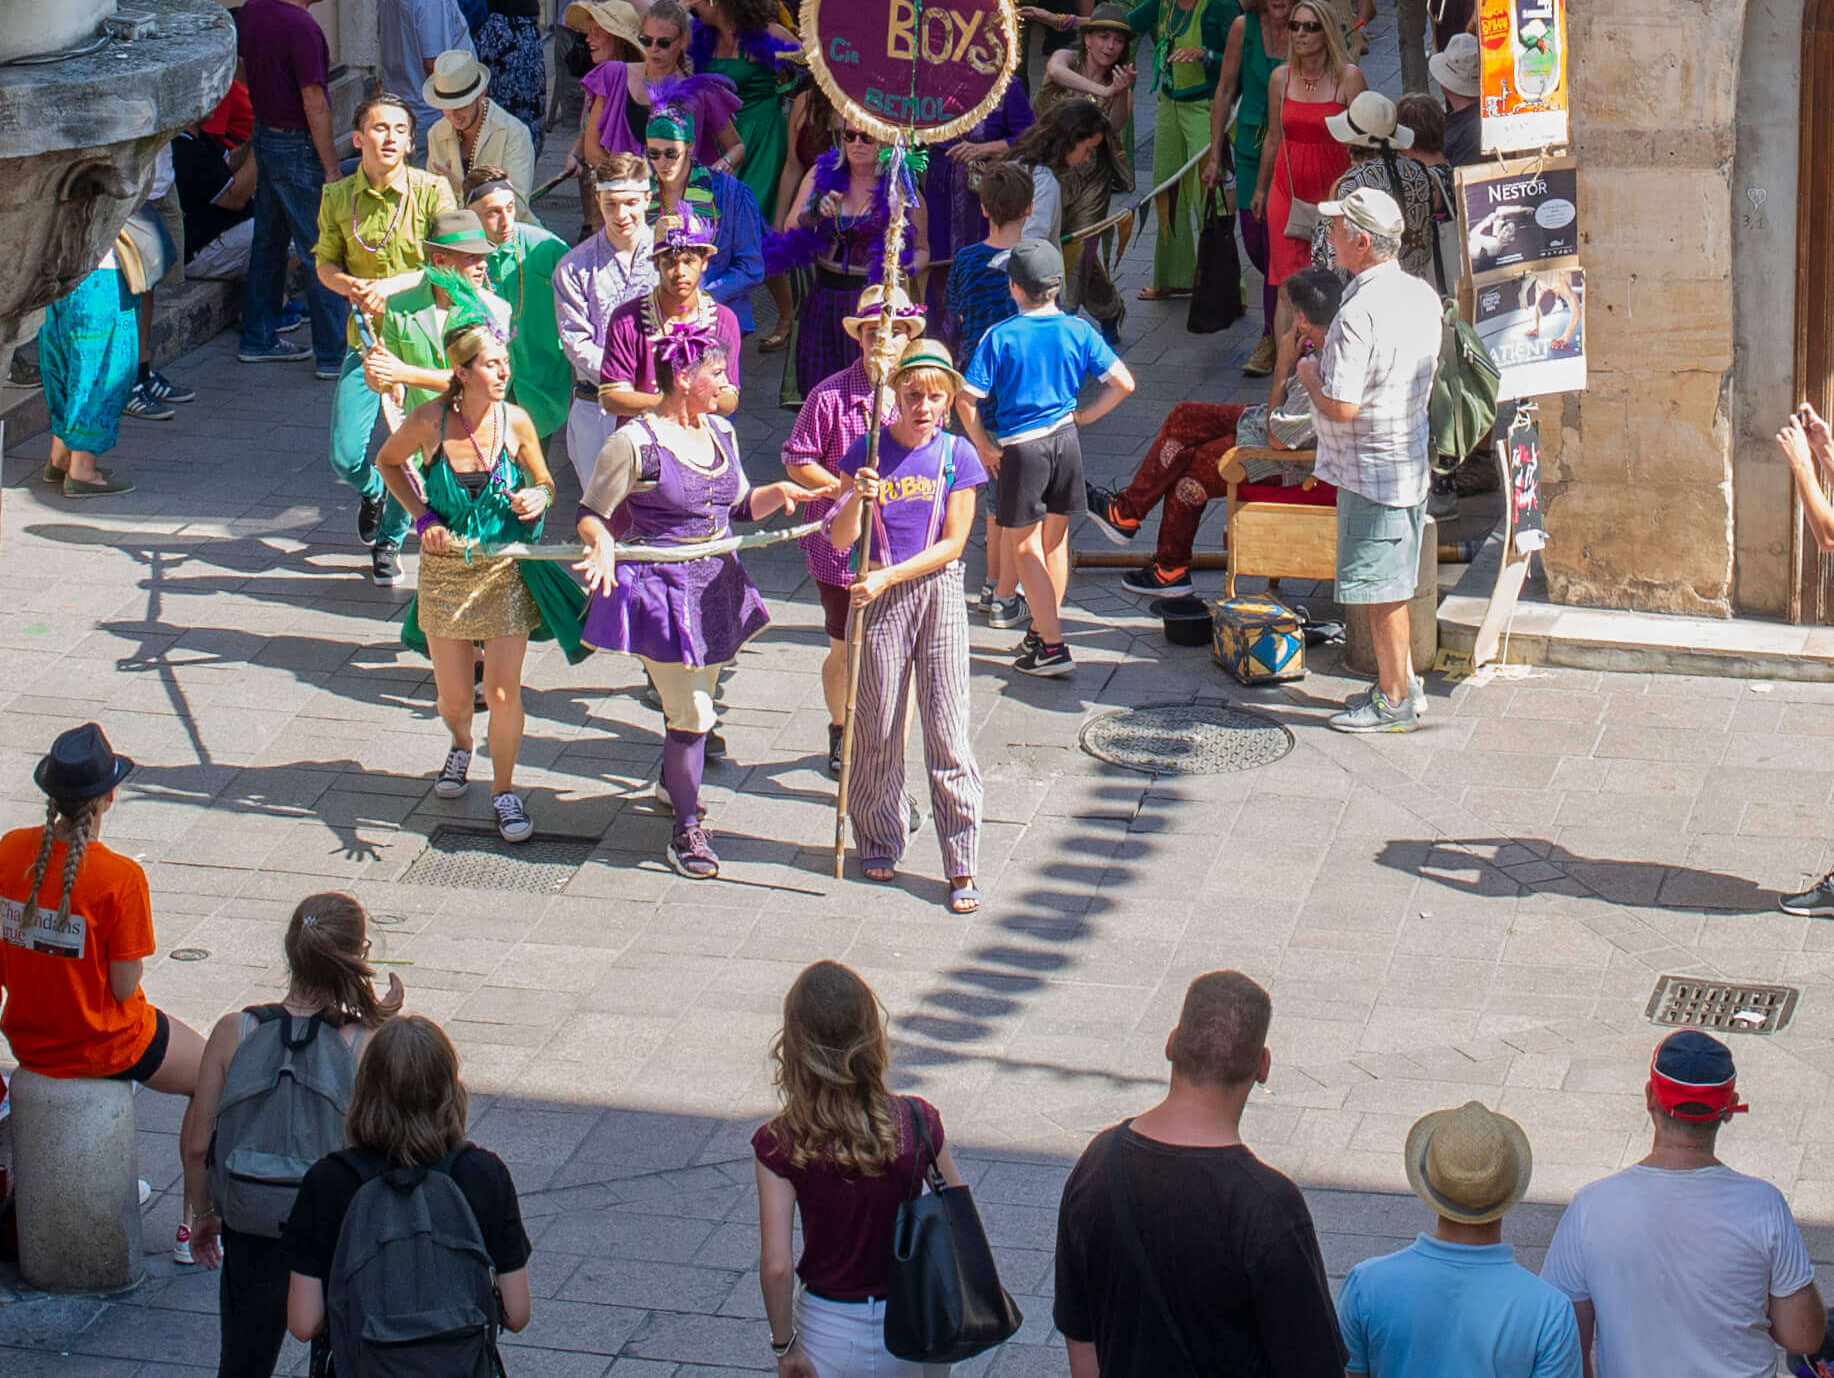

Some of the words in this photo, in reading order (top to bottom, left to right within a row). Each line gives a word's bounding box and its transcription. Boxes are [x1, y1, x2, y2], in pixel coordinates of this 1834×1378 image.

[863, 88, 955, 121] BEMOL
[1488, 181, 1548, 204] NESTOR
[1490, 337, 1552, 364] ATIENT
